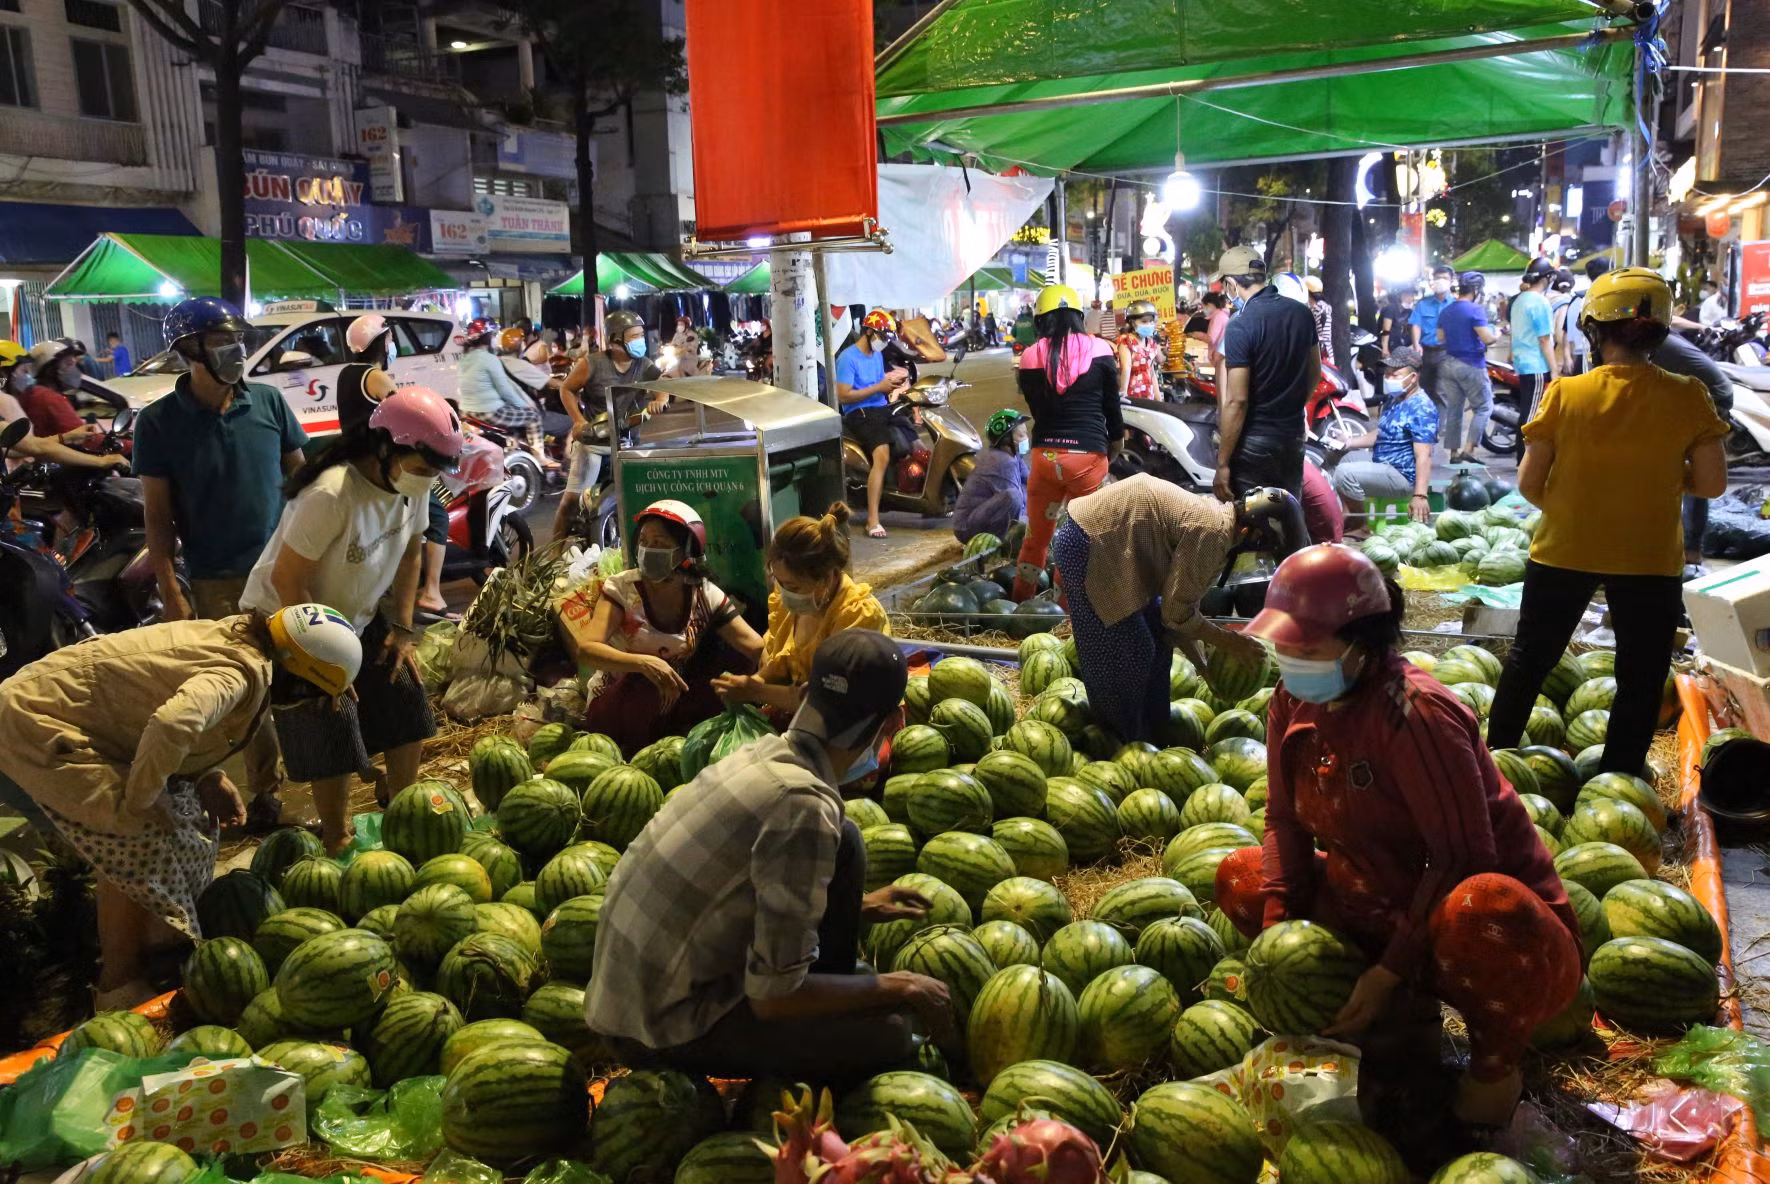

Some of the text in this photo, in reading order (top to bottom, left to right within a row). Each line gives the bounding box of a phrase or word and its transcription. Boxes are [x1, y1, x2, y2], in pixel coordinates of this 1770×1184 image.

[361, 126, 387, 142] 162
[440, 222, 467, 240] 162
[647, 468, 729, 480] CÔNG TY TNHH MTV
[670, 480, 695, 492] CÔNG
